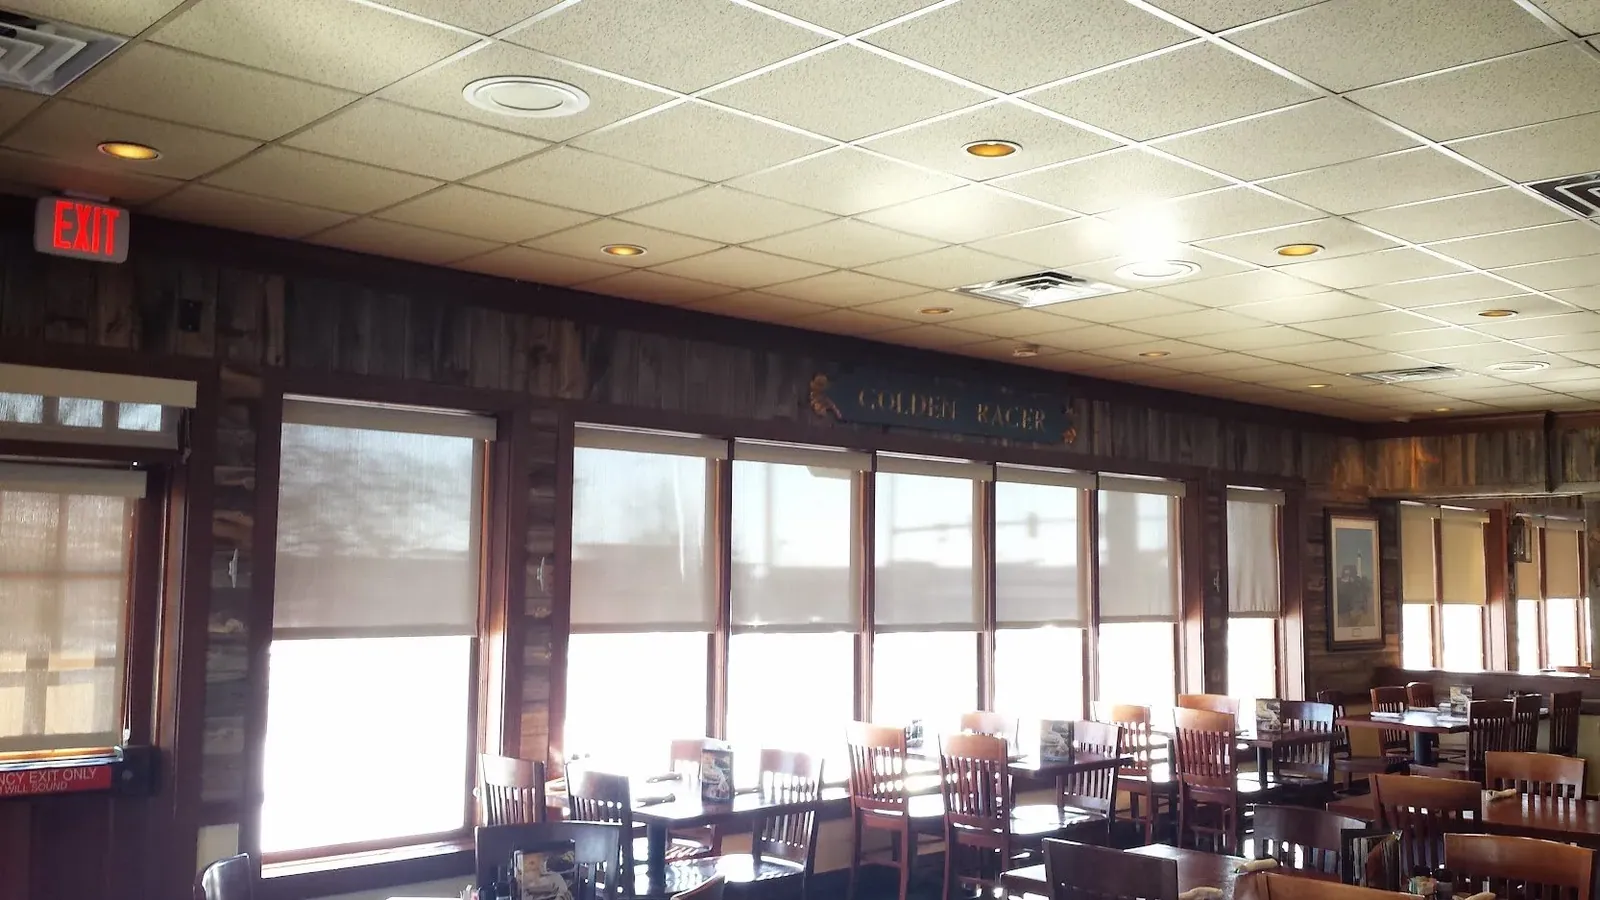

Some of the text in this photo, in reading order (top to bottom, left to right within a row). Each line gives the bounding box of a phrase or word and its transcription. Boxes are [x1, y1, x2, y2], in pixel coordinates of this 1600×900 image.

[53, 200, 120, 256] EXIT
[858, 388, 1046, 432] GOLDEN RACER
[4, 783, 28, 793] WILL
[31, 781, 68, 792] SOUND
[29, 769, 59, 783] EXIT
[63, 766, 97, 781] ONLY
